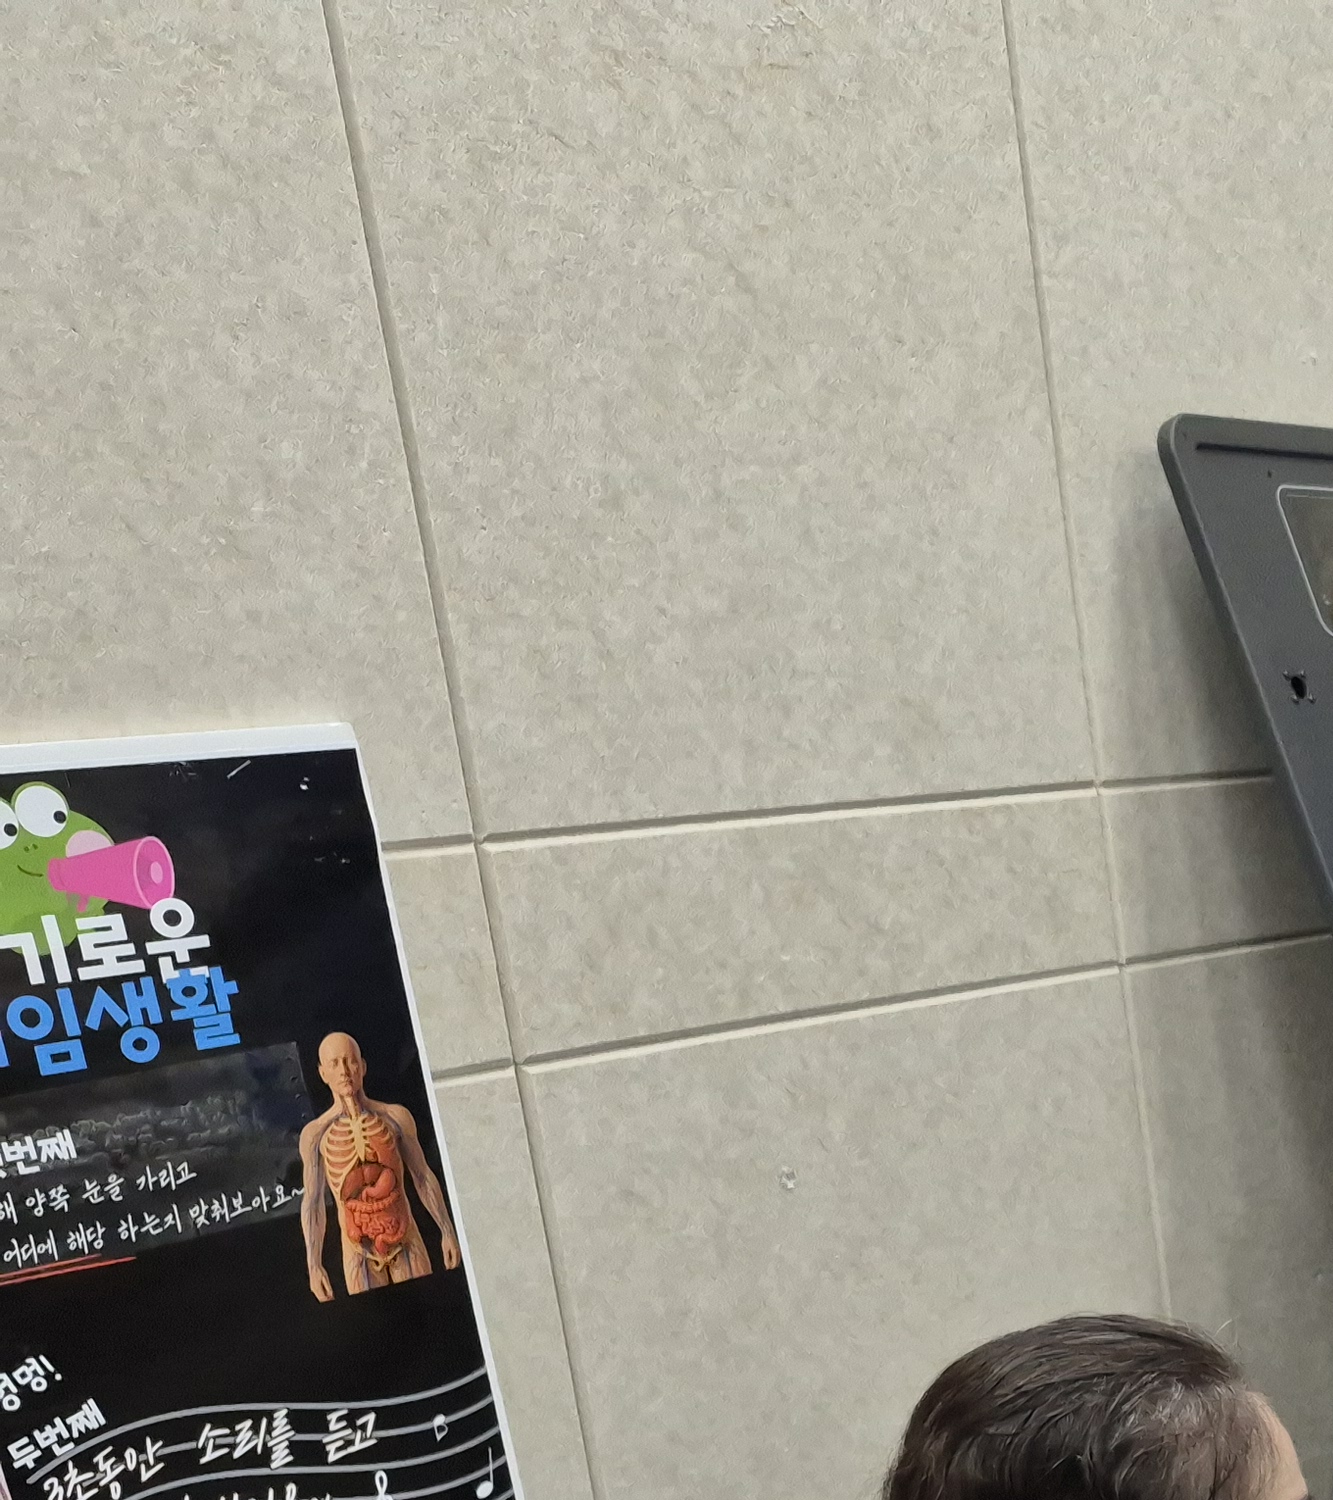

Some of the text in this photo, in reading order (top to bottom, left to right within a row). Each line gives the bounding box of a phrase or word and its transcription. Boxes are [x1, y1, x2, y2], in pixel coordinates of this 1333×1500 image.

[0, 897, 211, 985] 기로운
[0, 966, 241, 1077] 임생활
[0, 1129, 77, 1178] 번째
[26, 1184, 70, 1217] 양쪽
[82, 1174, 125, 1205] 눈을
[136, 1161, 197, 1192] 가리고
[4, 1229, 58, 1269] 어디에
[67, 1221, 106, 1255] 해당
[117, 1203, 182, 1243] 하는지
[7, 1397, 106, 1470] 두번째
[198, 1408, 298, 1469] 소리를
[322, 1408, 377, 1463] 듣고
